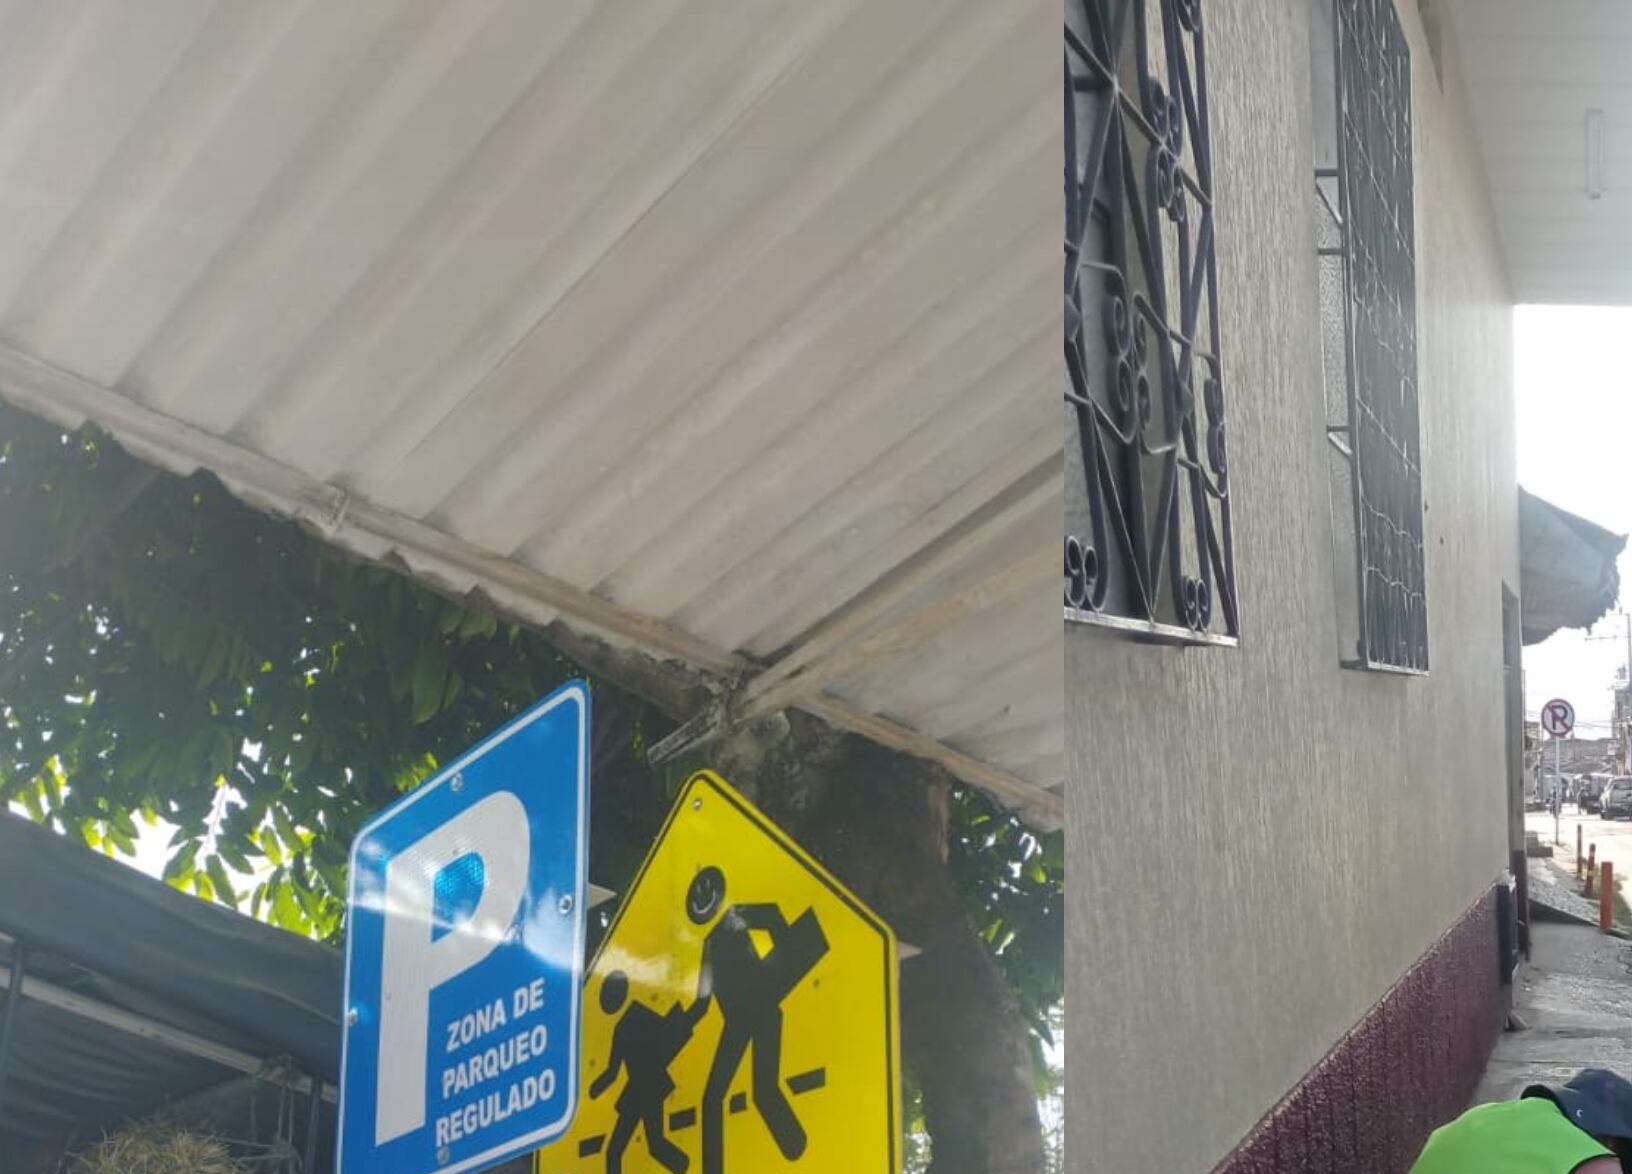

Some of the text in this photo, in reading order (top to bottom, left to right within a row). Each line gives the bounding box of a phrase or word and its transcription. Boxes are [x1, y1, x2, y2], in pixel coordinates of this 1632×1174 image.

[375, 790, 530, 1148] P
[446, 977, 545, 1053] ZONA DE
[442, 1025, 548, 1100] PARQUEO
[435, 1068, 556, 1148] REGULADO
